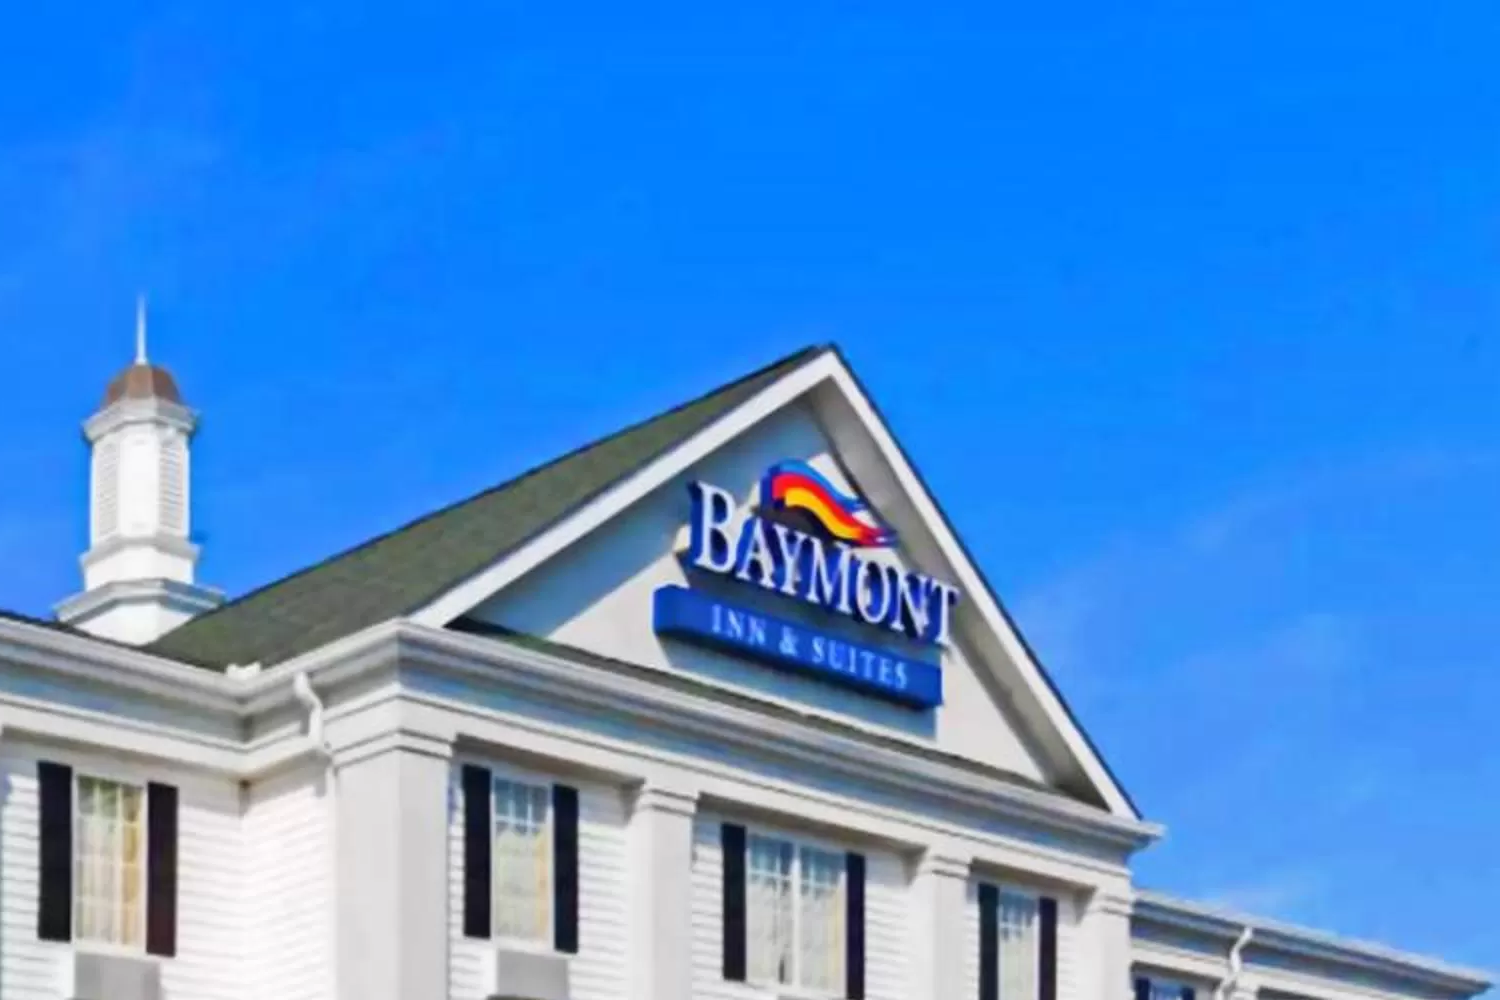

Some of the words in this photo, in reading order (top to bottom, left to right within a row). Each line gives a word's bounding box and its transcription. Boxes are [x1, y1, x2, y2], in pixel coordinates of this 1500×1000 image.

[689, 481, 957, 647] BAYMONT
[710, 603, 768, 646] INN
[778, 625, 799, 657] &
[811, 635, 909, 690] SUITES
